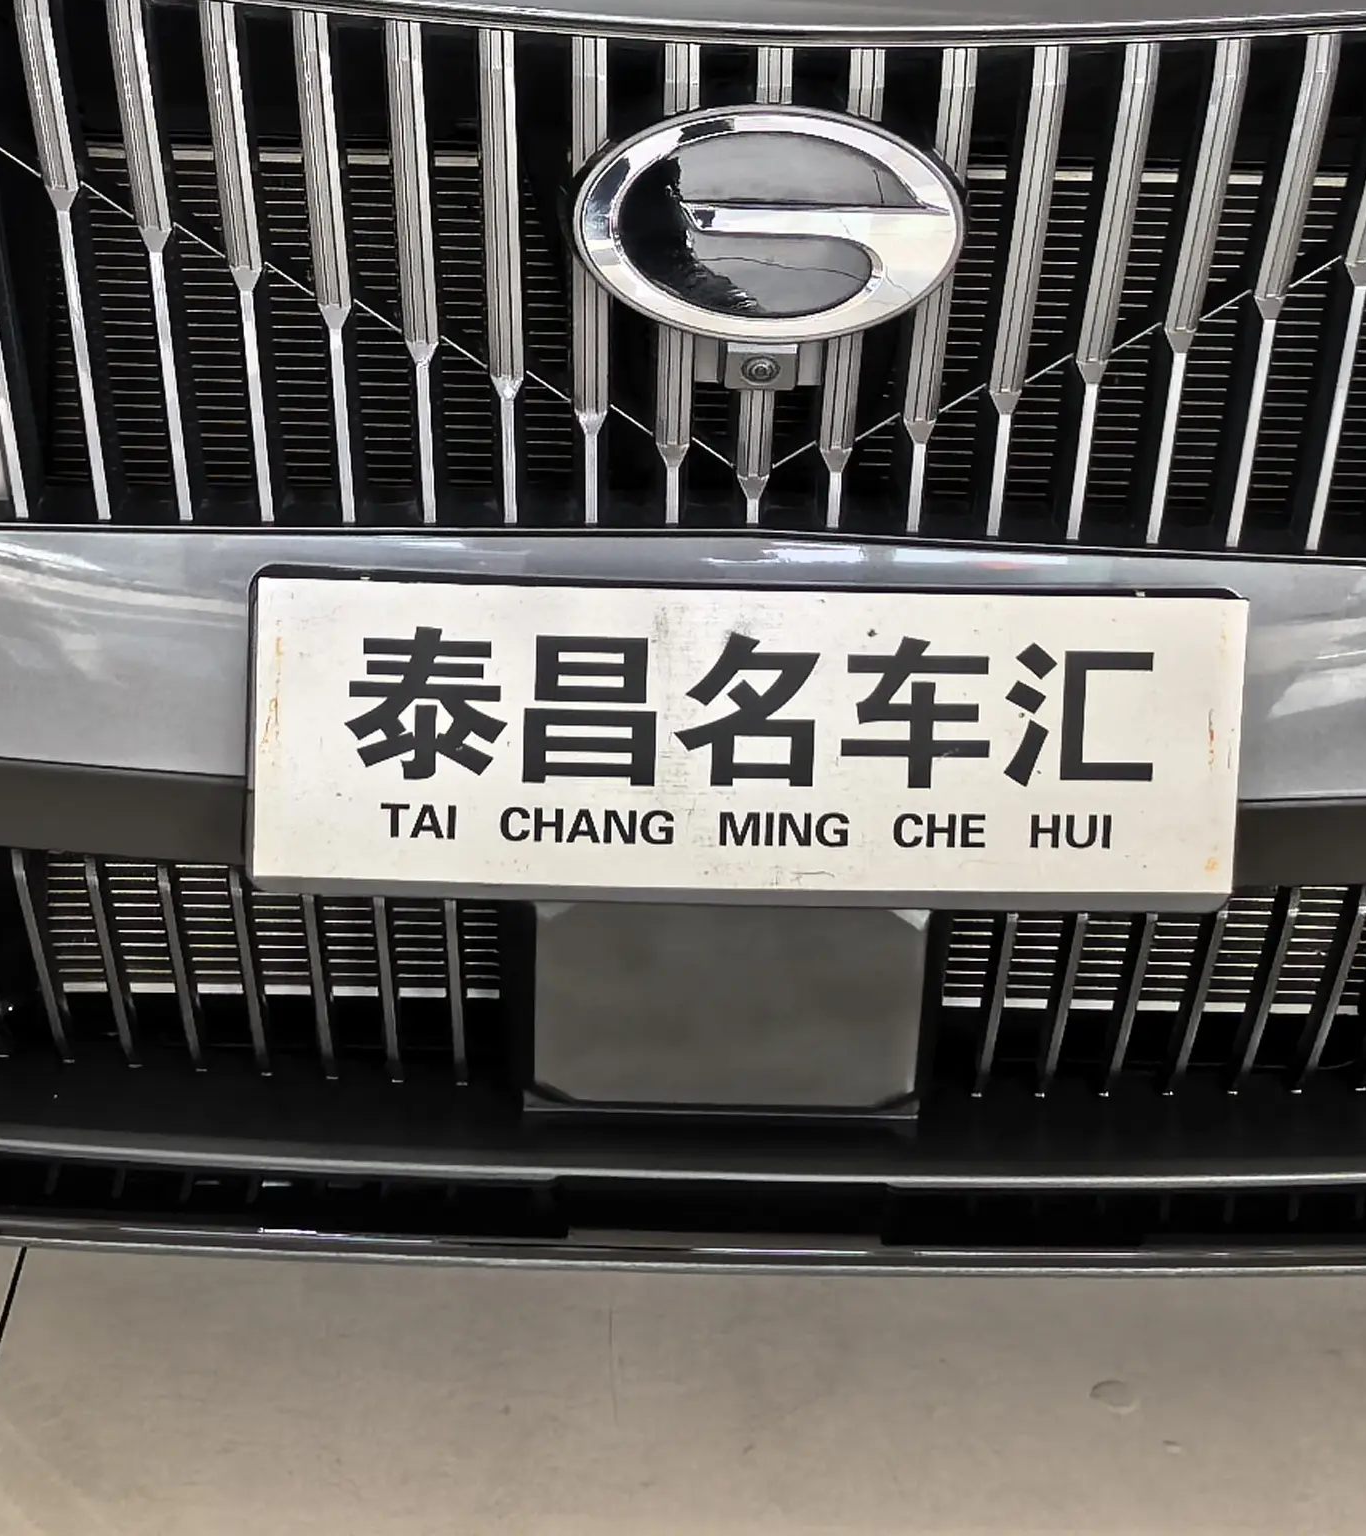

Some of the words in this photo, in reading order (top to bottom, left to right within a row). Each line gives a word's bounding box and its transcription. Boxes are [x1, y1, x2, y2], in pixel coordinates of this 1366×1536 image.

[344, 626, 1155, 789] 泰昌名车汇
[380, 802, 457, 840] TAI
[500, 806, 674, 845] CHANG
[719, 811, 850, 848] MING
[893, 813, 986, 848] CHE
[1029, 814, 1112, 849] HUI
